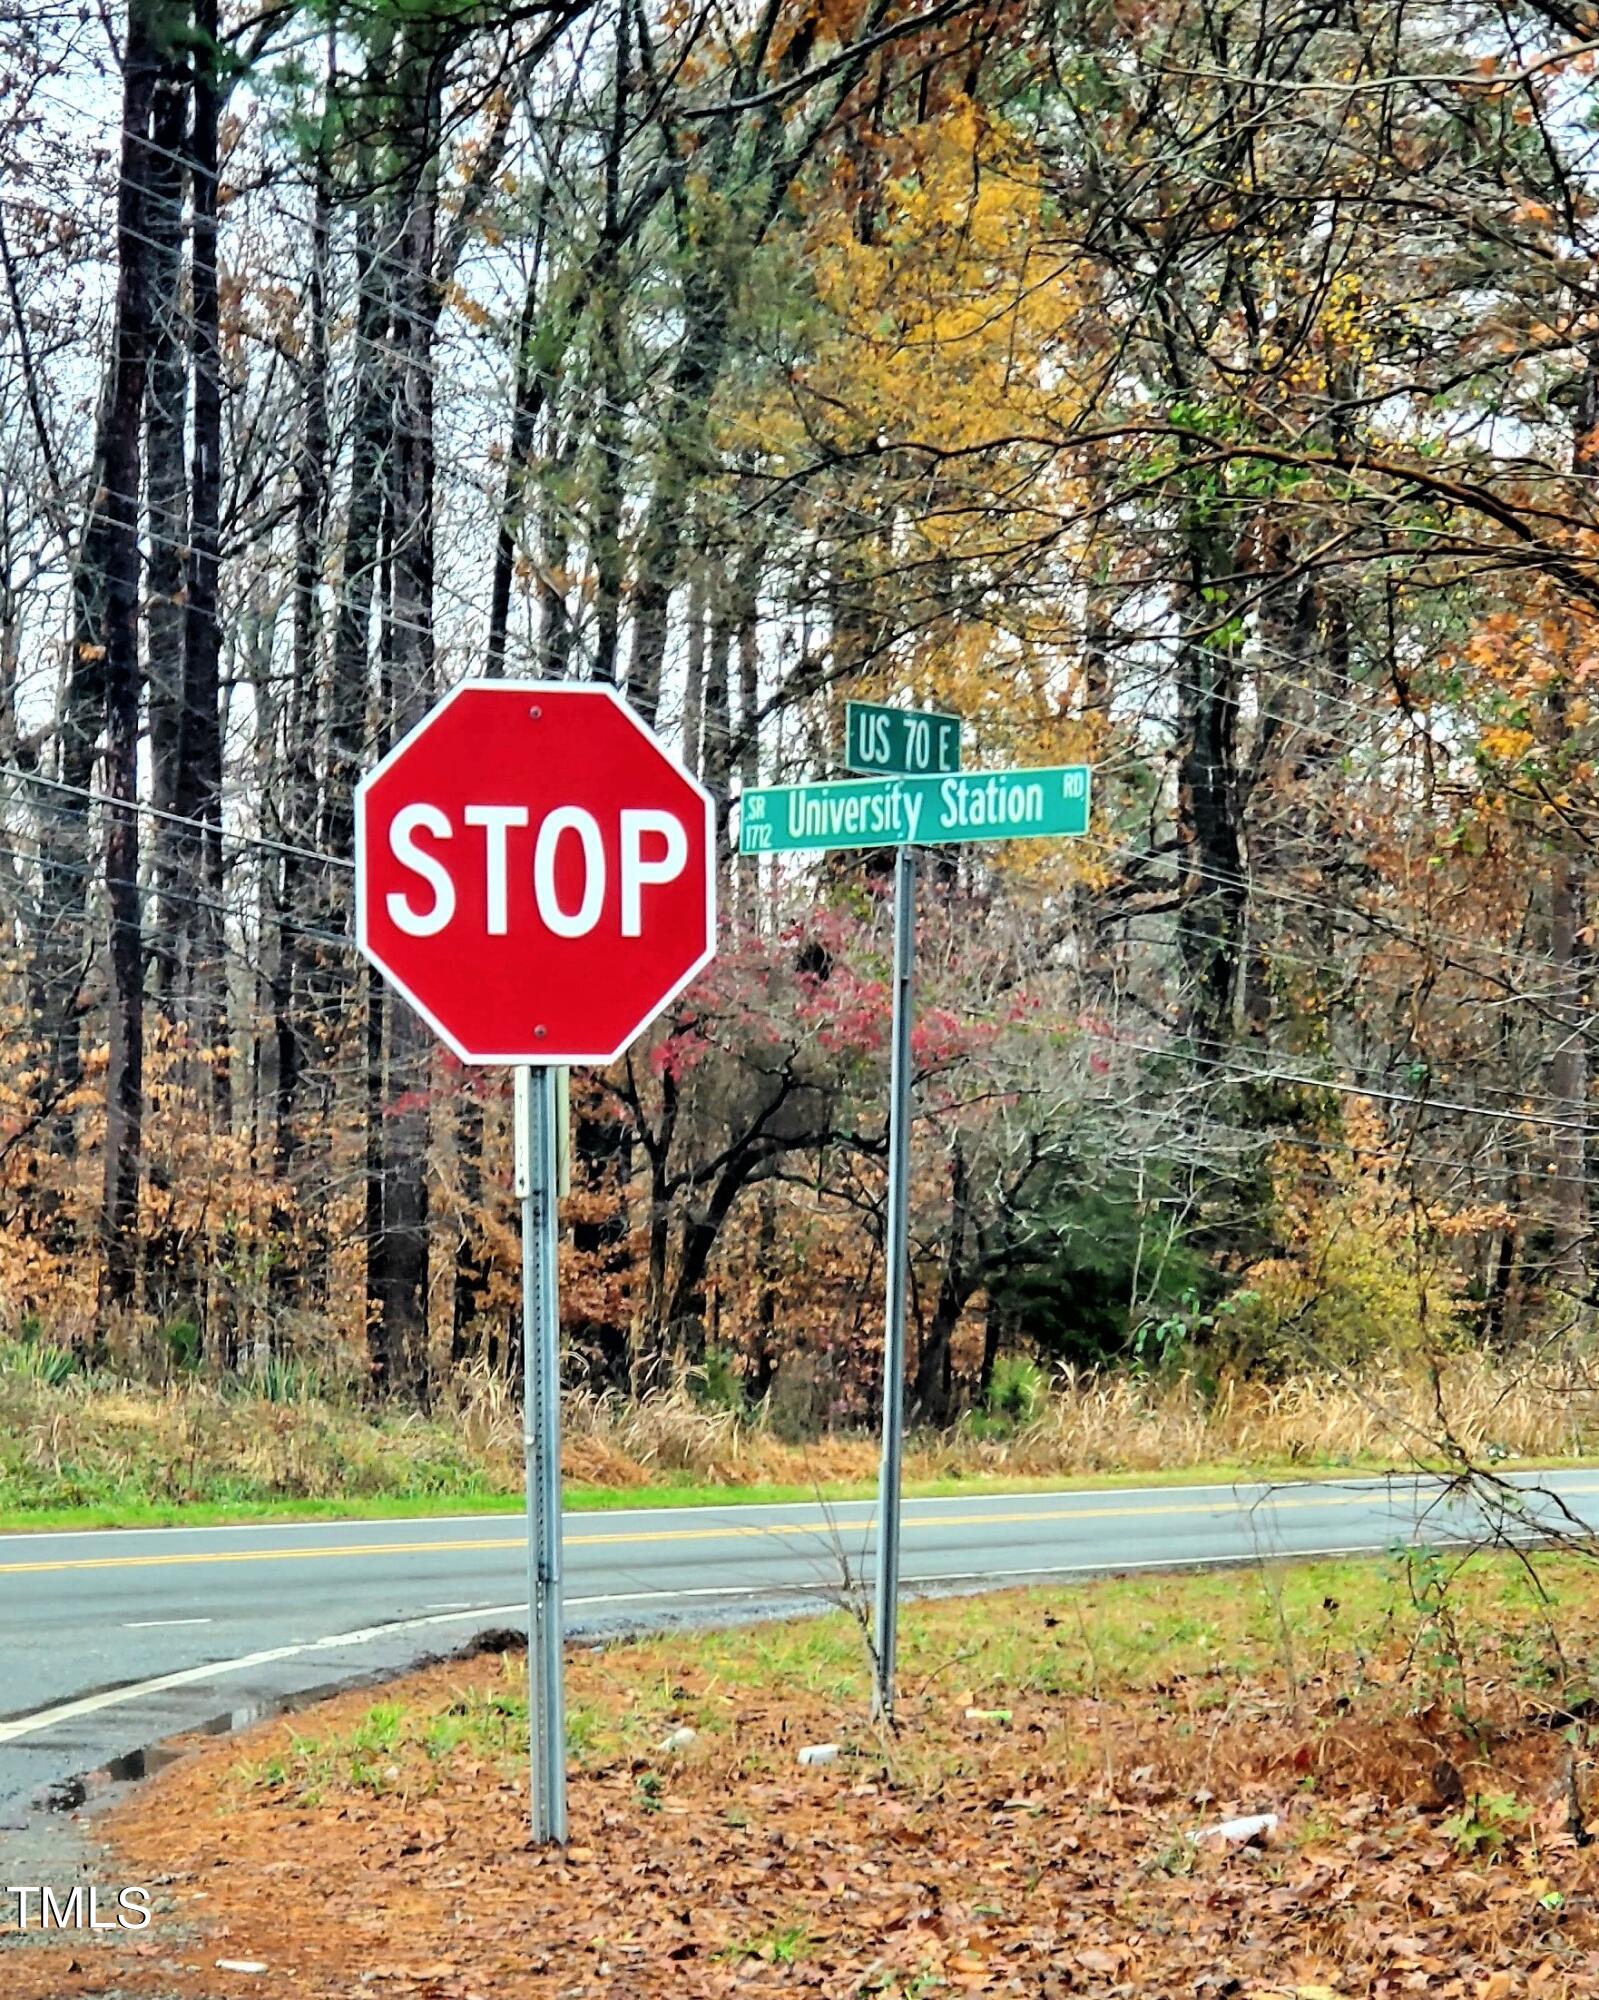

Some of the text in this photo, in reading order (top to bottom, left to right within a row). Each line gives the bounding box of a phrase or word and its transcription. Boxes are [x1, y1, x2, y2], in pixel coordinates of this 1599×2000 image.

[858, 713, 952, 771] US 70 E
[748, 795, 766, 821] SR
[788, 772, 1084, 841] University Station RD
[746, 823, 772, 850] 1712
[386, 803, 688, 938] STOP
